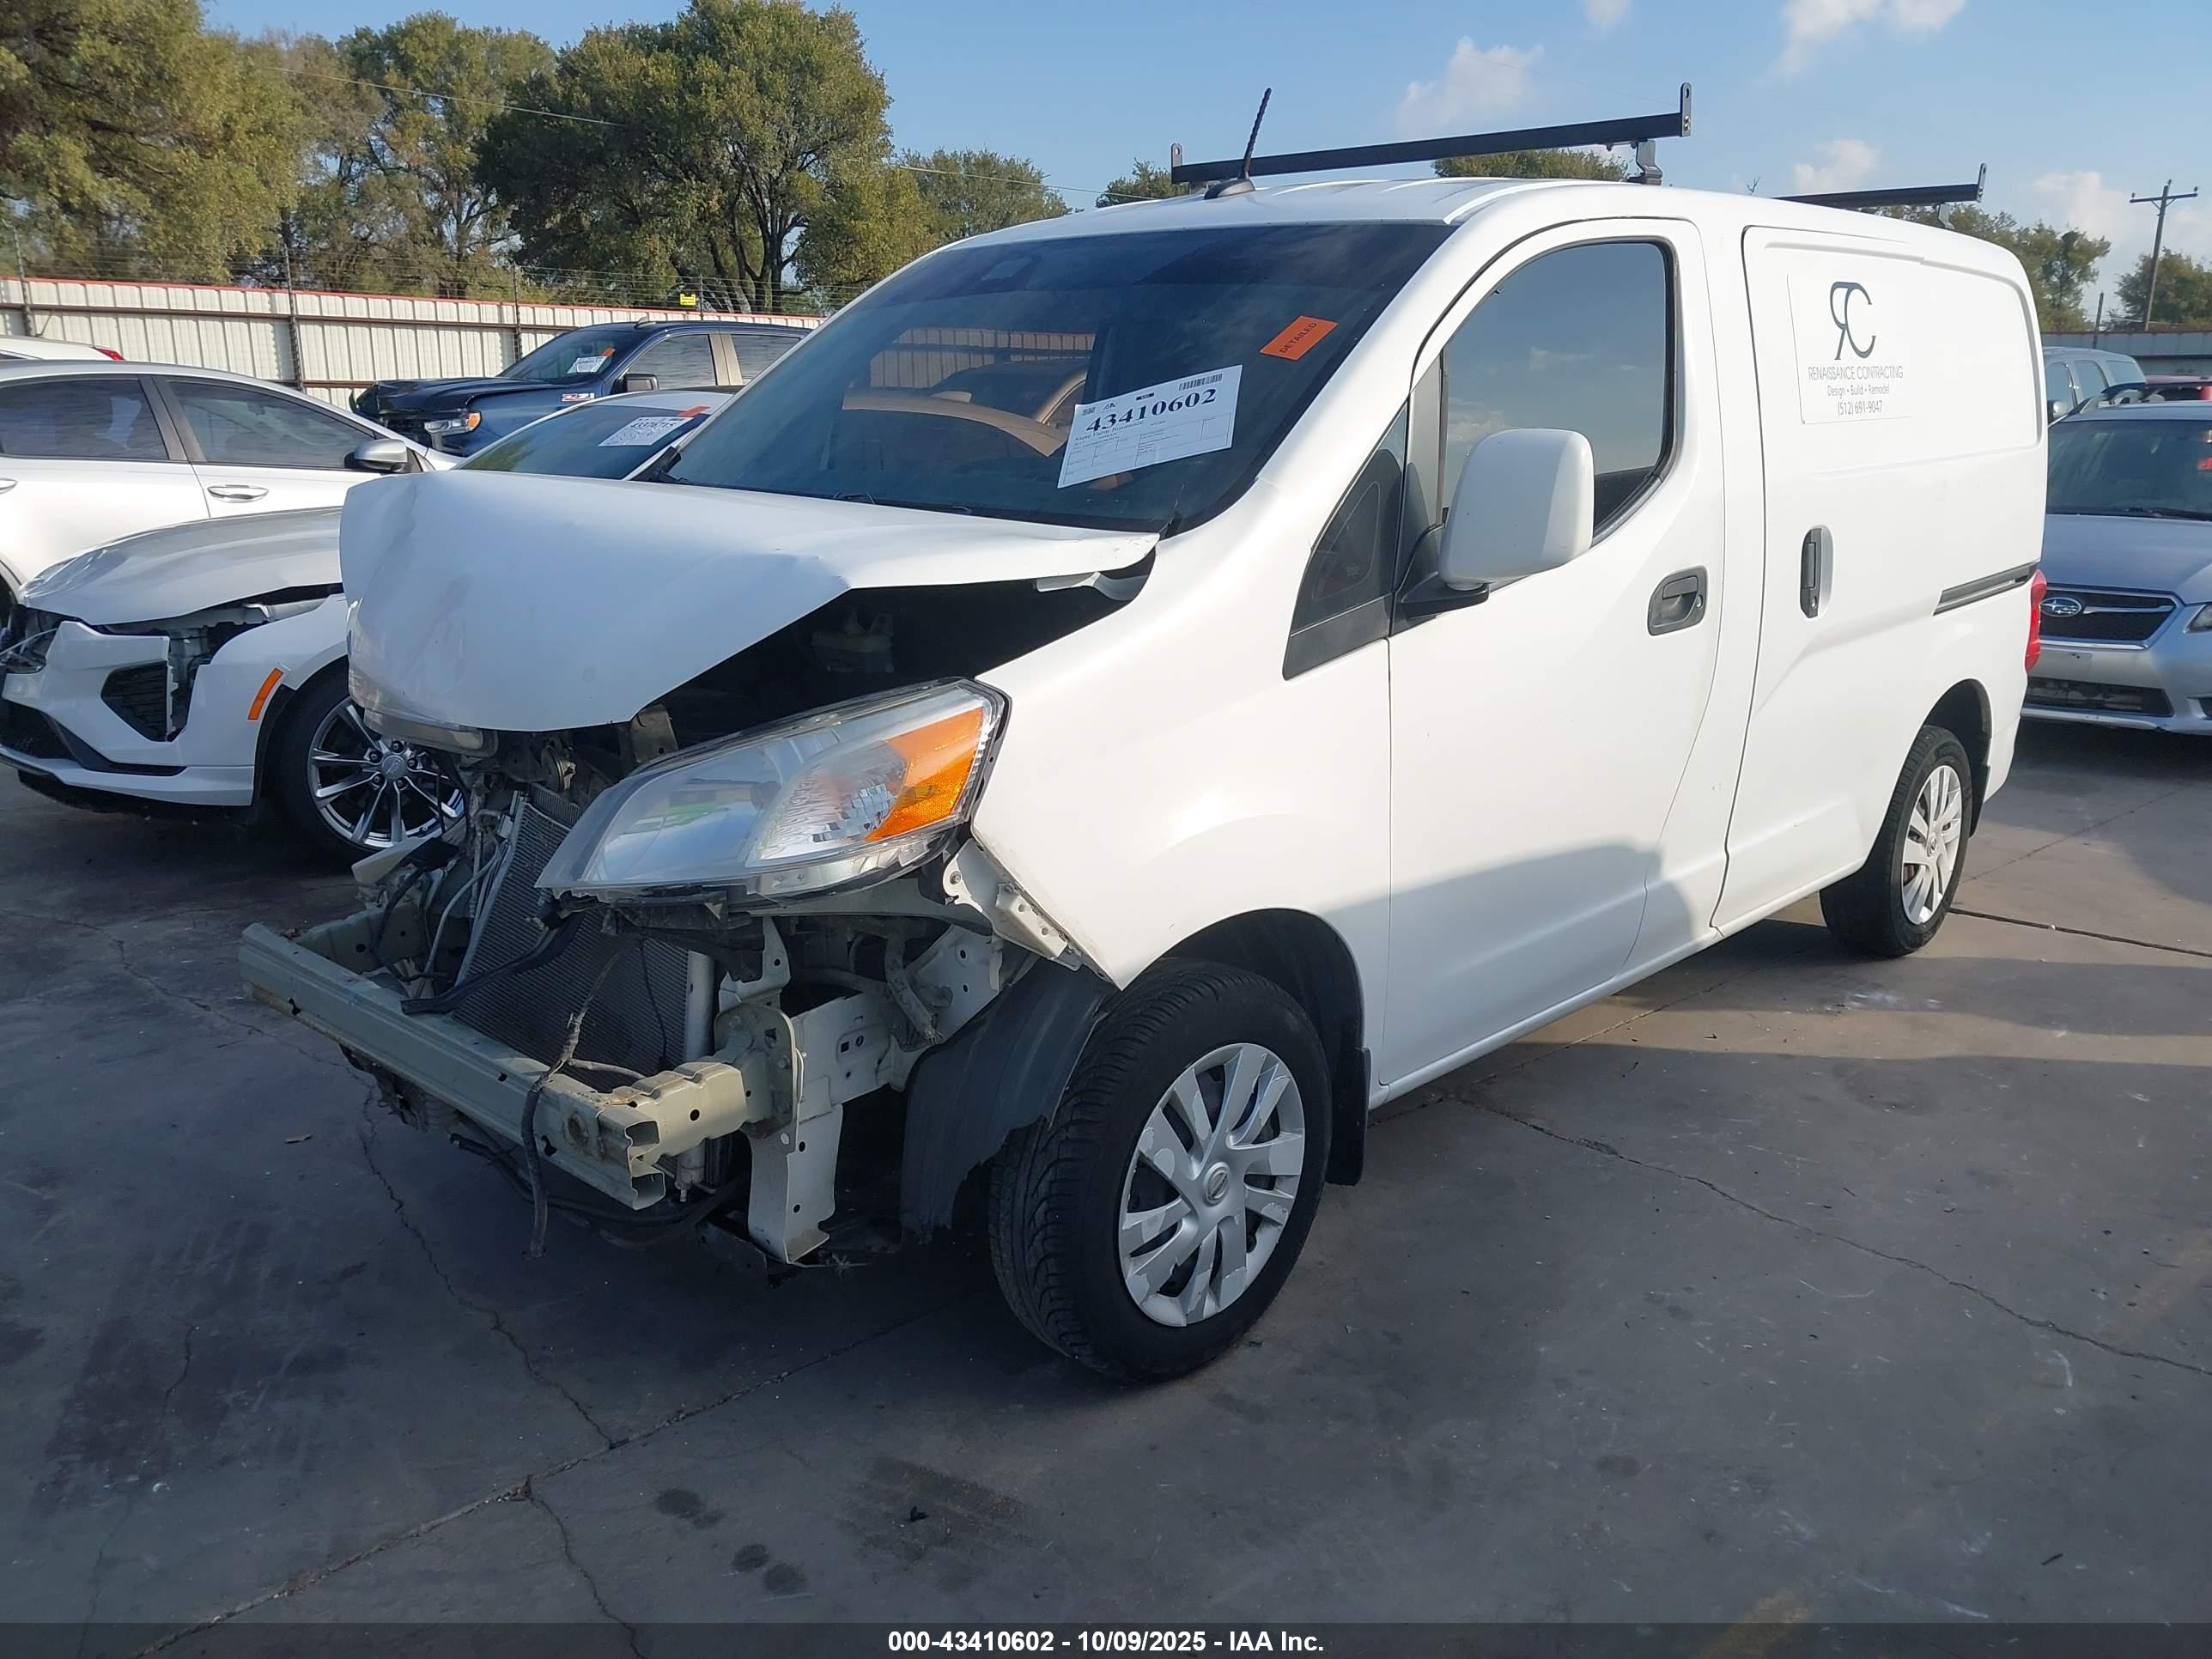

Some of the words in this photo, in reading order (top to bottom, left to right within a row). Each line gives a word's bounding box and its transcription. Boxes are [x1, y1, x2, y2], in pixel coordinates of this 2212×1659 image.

[1279, 322, 1317, 353] DETAILED
[1808, 366, 1855, 380] RENAISSANCE
[1856, 365, 1904, 380] CONTRACTING
[1827, 385, 1846, 399] Design
[1850, 384, 1864, 396] Build
[1869, 383, 1890, 395] Remodel
[1086, 388, 1217, 433] 43410602
[1838, 400, 1854, 417] (512)
[1855, 399, 1883, 414] 691-9047
